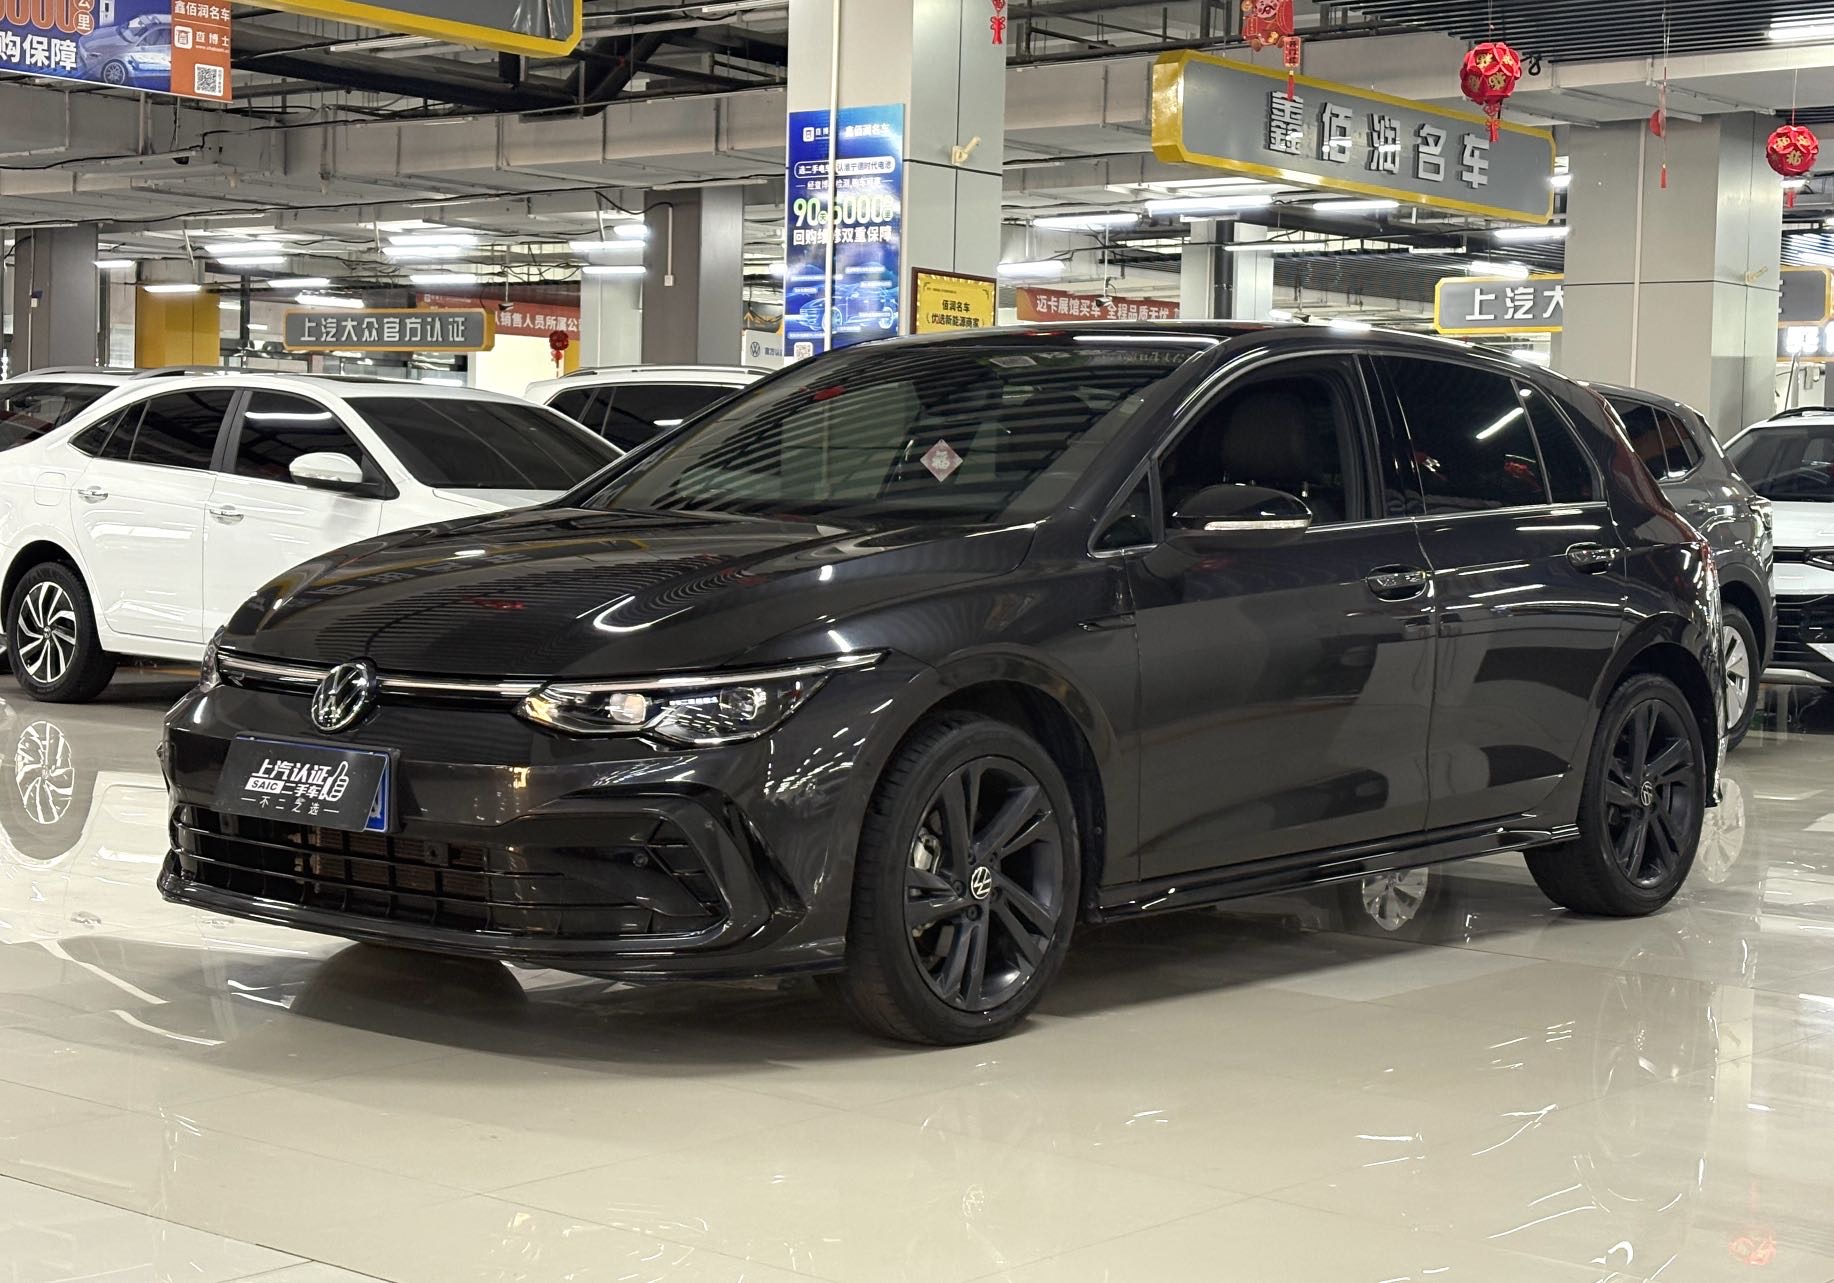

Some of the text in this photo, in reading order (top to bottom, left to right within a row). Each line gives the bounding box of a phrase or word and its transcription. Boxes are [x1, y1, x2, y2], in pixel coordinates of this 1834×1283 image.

[174, 1, 230, 21] 鑫佰润名车
[195, 31, 229, 47] 查博士
[0, 30, 77, 71] 购保障
[1269, 90, 1489, 190] 鑫佰润名车
[942, 300, 970, 313] 佰润名车
[301, 316, 466, 343] 上汽大众官方认证
[251, 758, 332, 785] 上汽认证
[251, 779, 279, 792] SAIC
[281, 782, 321, 799] 二手车
[259, 795, 320, 816] 不二之选
